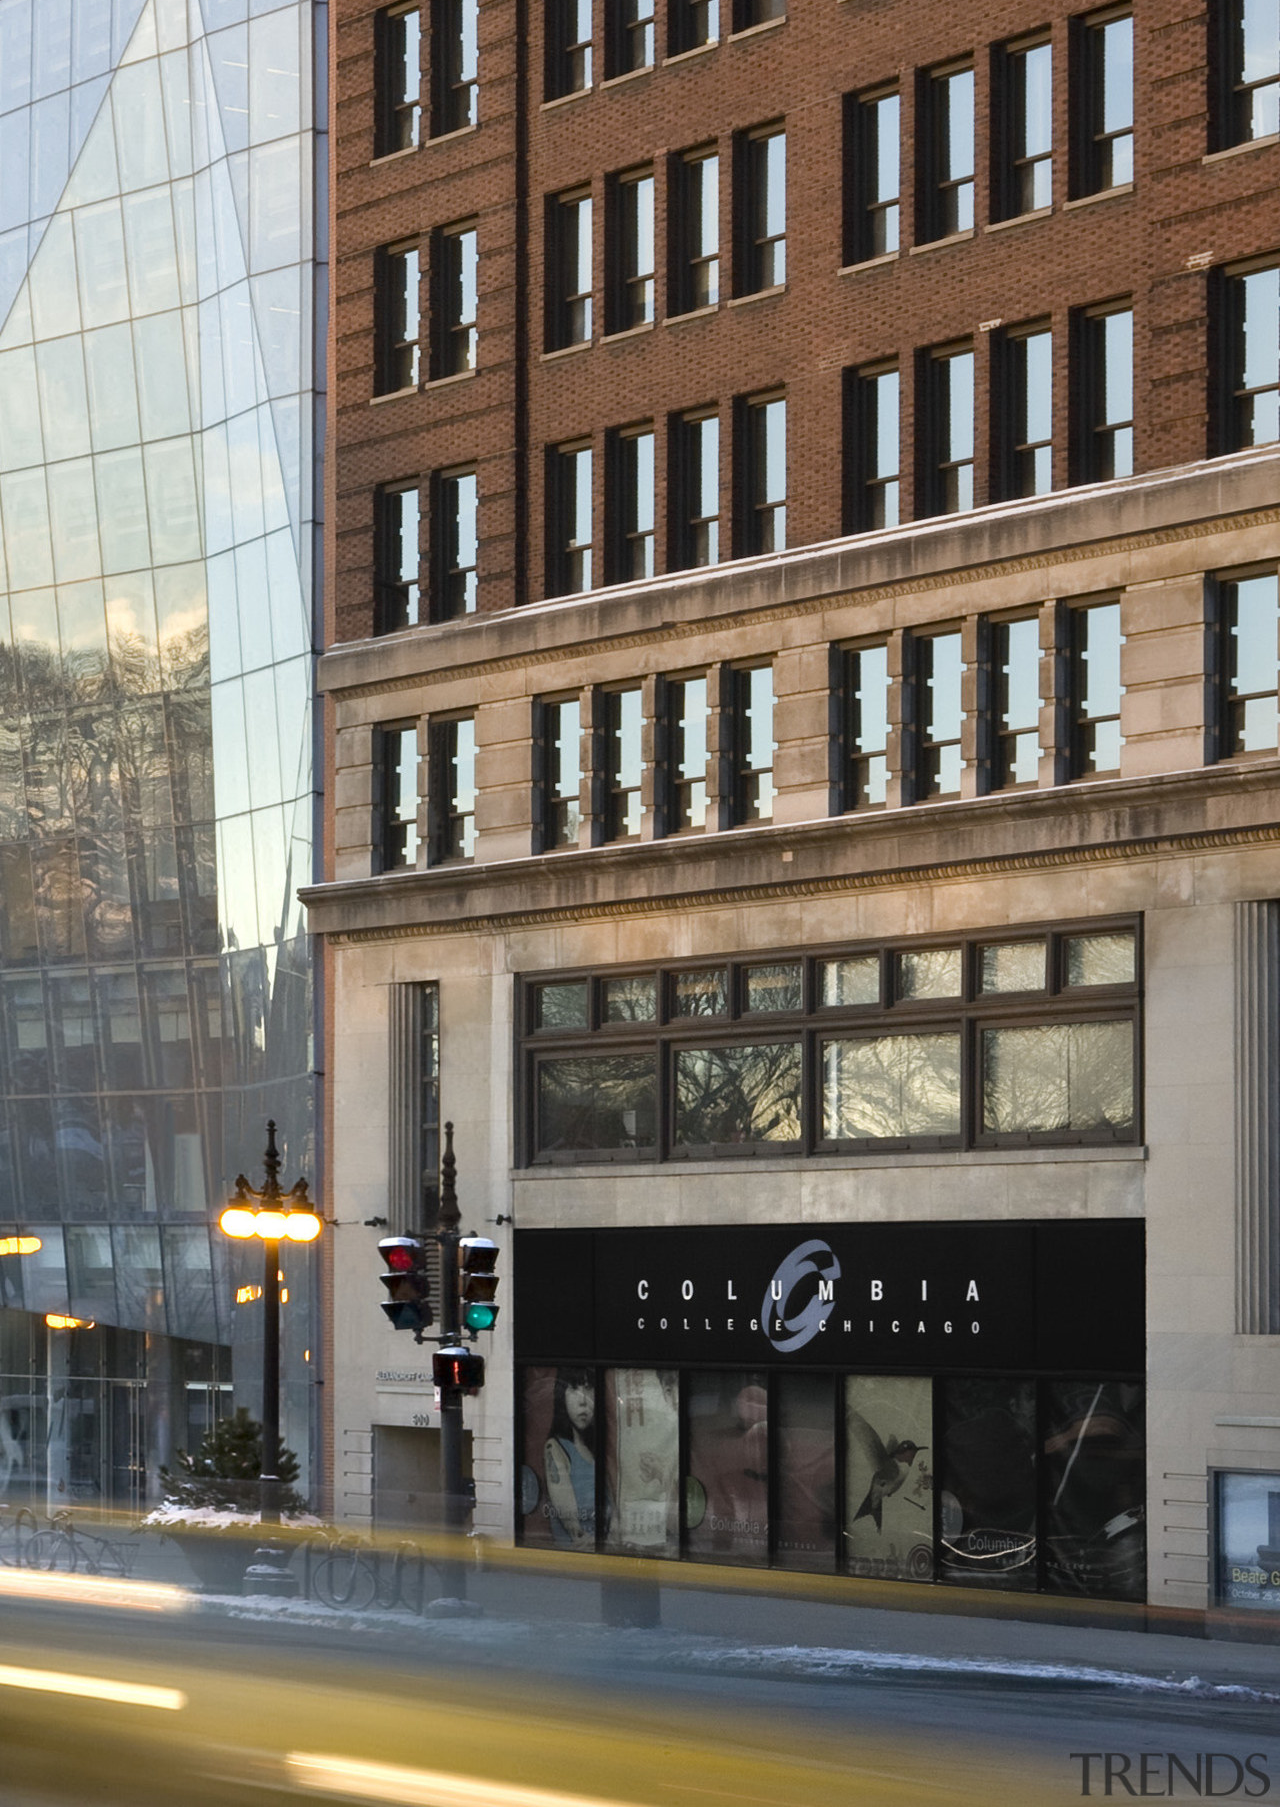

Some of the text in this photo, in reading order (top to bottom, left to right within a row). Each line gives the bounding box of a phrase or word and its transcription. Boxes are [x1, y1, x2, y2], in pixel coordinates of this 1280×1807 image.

[637, 1279, 980, 1302] COLUMBIA
[637, 1318, 980, 1335] COLLEGE CHICAGO
[1231, 1567, 1268, 1584] Beate
